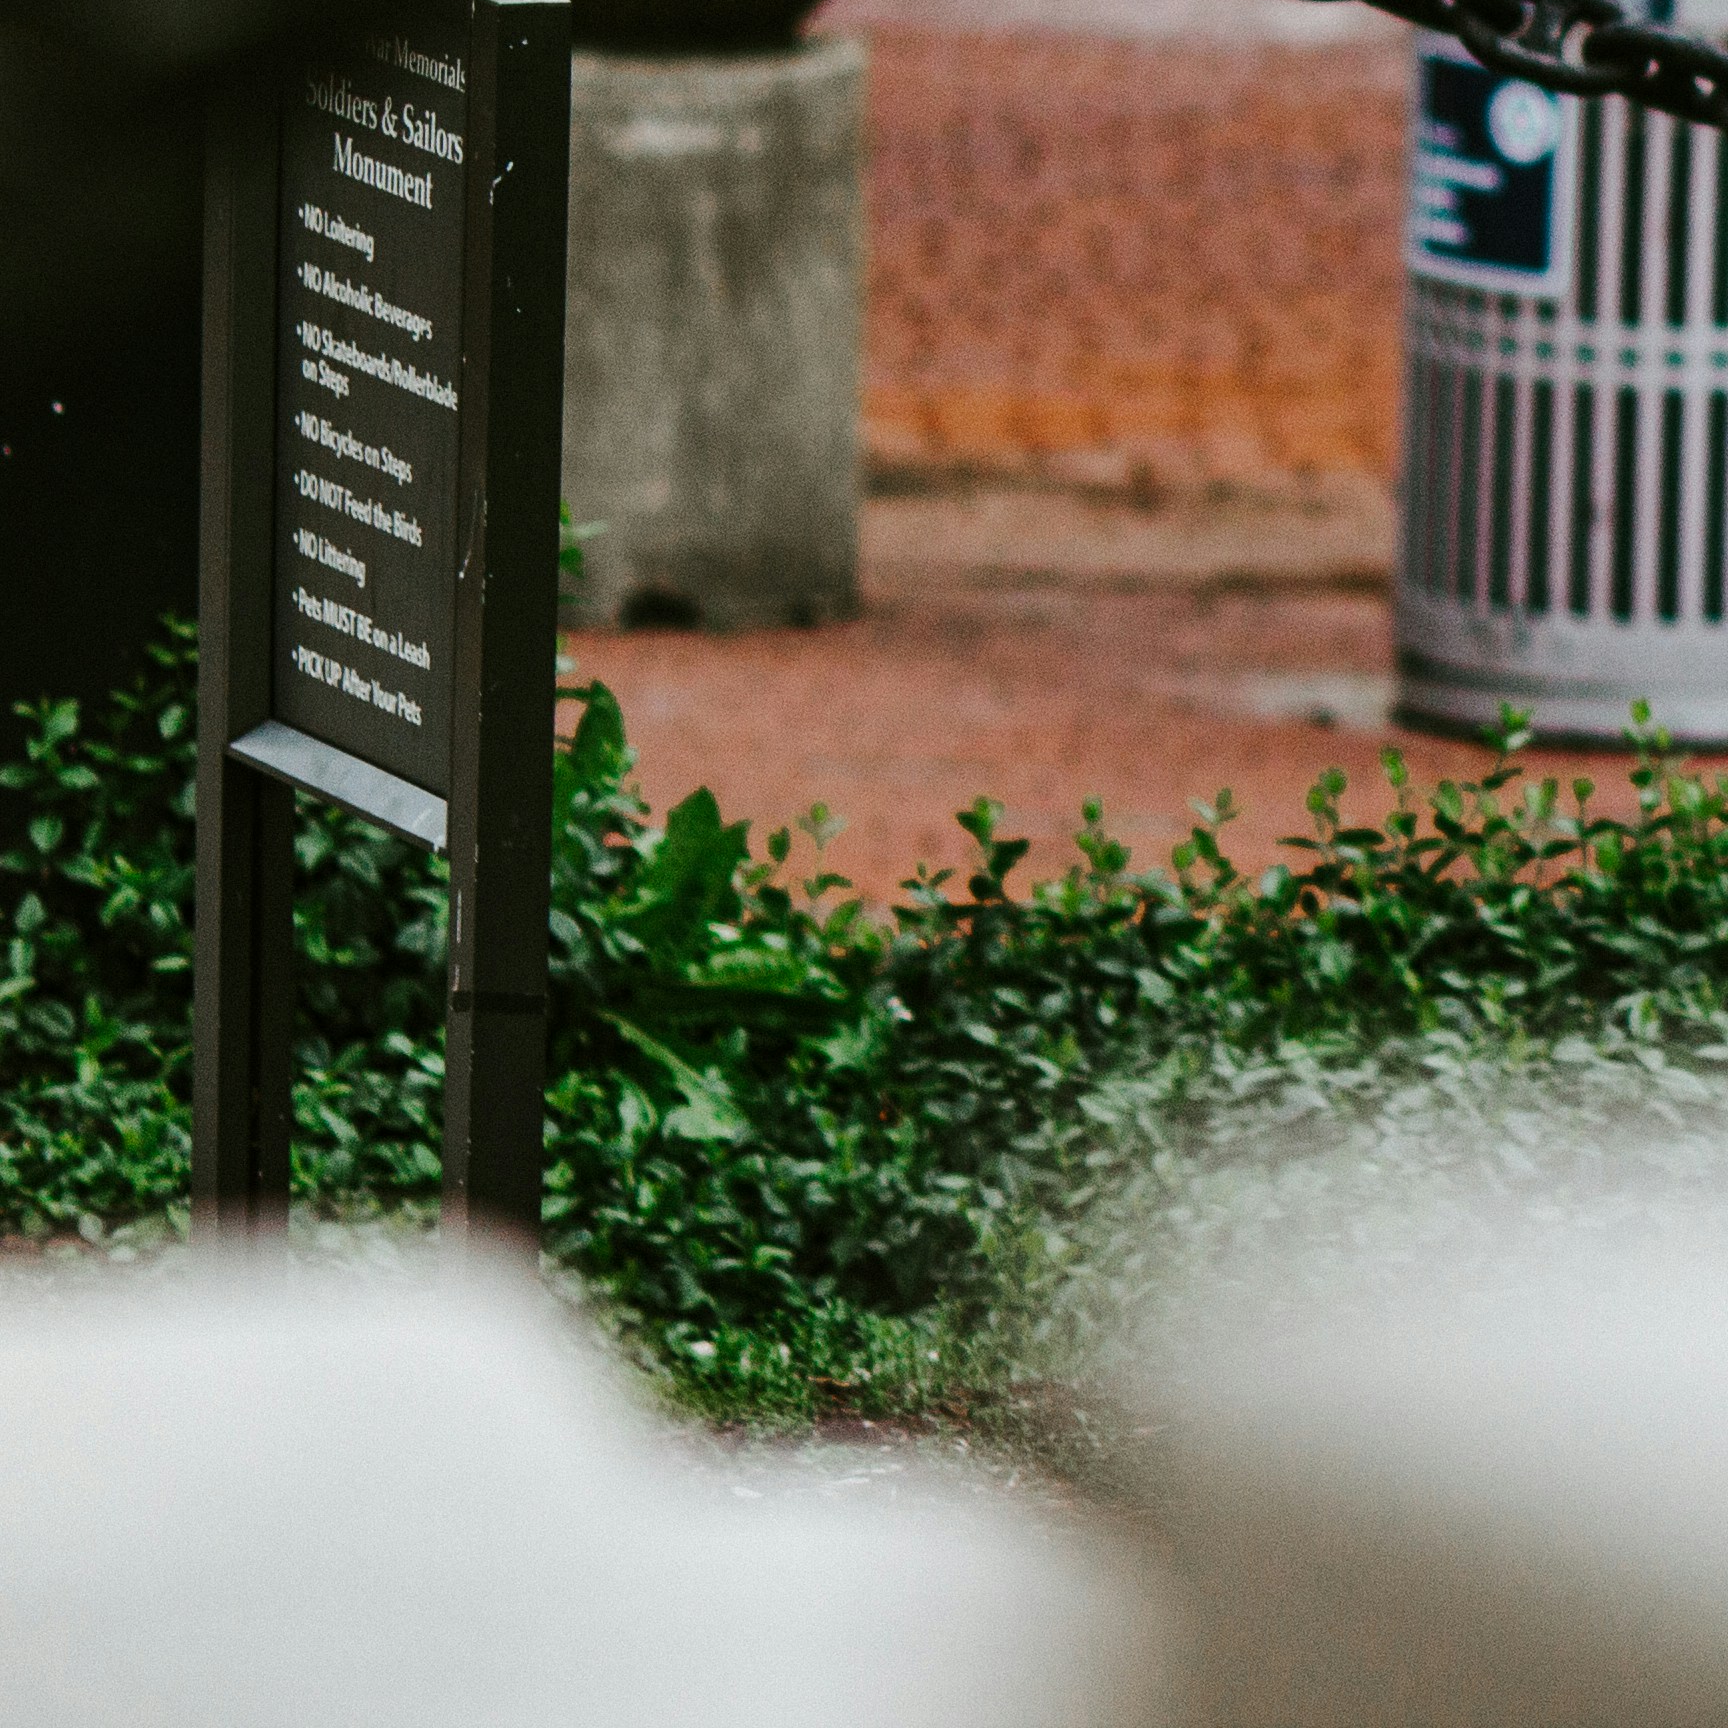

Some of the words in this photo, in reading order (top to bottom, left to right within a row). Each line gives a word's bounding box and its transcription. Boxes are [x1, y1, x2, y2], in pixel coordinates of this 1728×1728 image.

[306, 74, 377, 130] Soldiers
[382, 95, 398, 139] &
[402, 103, 463, 165] Sailors
[332, 131, 433, 210] Monument
[304, 202, 323, 234] NO
[324, 210, 375, 263] Loitering
[302, 320, 321, 352] NO
[303, 261, 322, 293] NO
[322, 271, 374, 316] Alcoholic
[374, 291, 433, 342] Beverages
[302, 358, 318, 383] on
[318, 359, 350, 400] Steps
[301, 410, 320, 443] NO
[320, 419, 363, 462] Bicycles
[364, 445, 381, 470] on
[380, 446, 413, 487] Steps
[300, 469, 319, 501] DO
[319, 476, 344, 513] NOT
[344, 488, 373, 526] Feed
[373, 502, 392, 534] the
[392, 510, 423, 548] Birds
[299, 527, 318, 560] NO
[318, 536, 366, 589] Littering
[298, 586, 323, 622] Pets
[323, 597, 357, 637] MUST
[356, 613, 373, 645] BE
[373, 627, 390, 653] on
[389, 633, 398, 656] a
[397, 631, 431, 671] Leash
[298, 644, 325, 682] PICK
[324, 656, 342, 688] UP
[342, 665, 371, 702] After
[371, 678, 397, 716] Your
[396, 691, 422, 726] Pets
